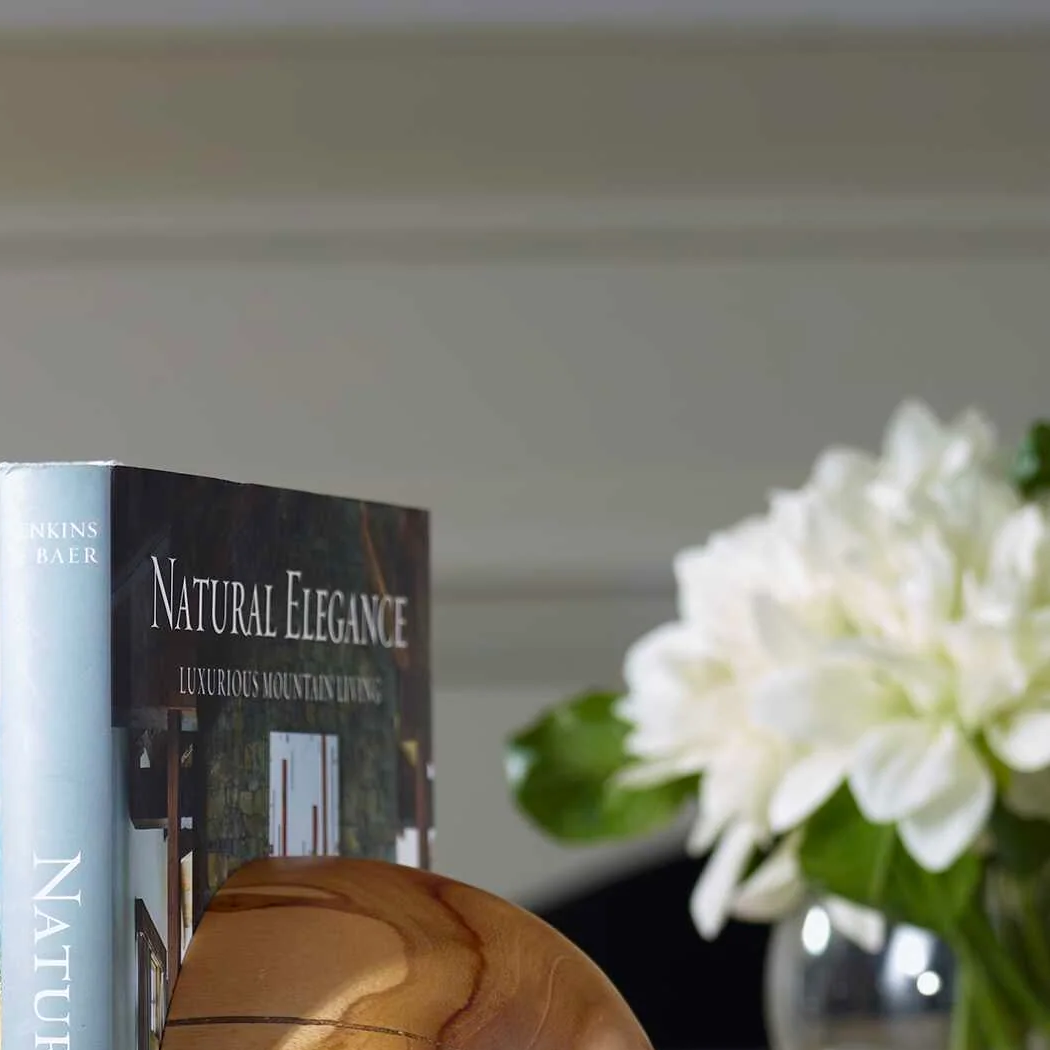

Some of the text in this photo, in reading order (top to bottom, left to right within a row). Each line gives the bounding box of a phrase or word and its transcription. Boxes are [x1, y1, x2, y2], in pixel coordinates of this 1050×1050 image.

[26, 520, 98, 539] NKINS
[36, 546, 99, 565] BAER
[150, 555, 409, 649] NATURAL ELEGANCE
[179, 665, 381, 705] LUXURIOUS MOUNTAIN LIVING
